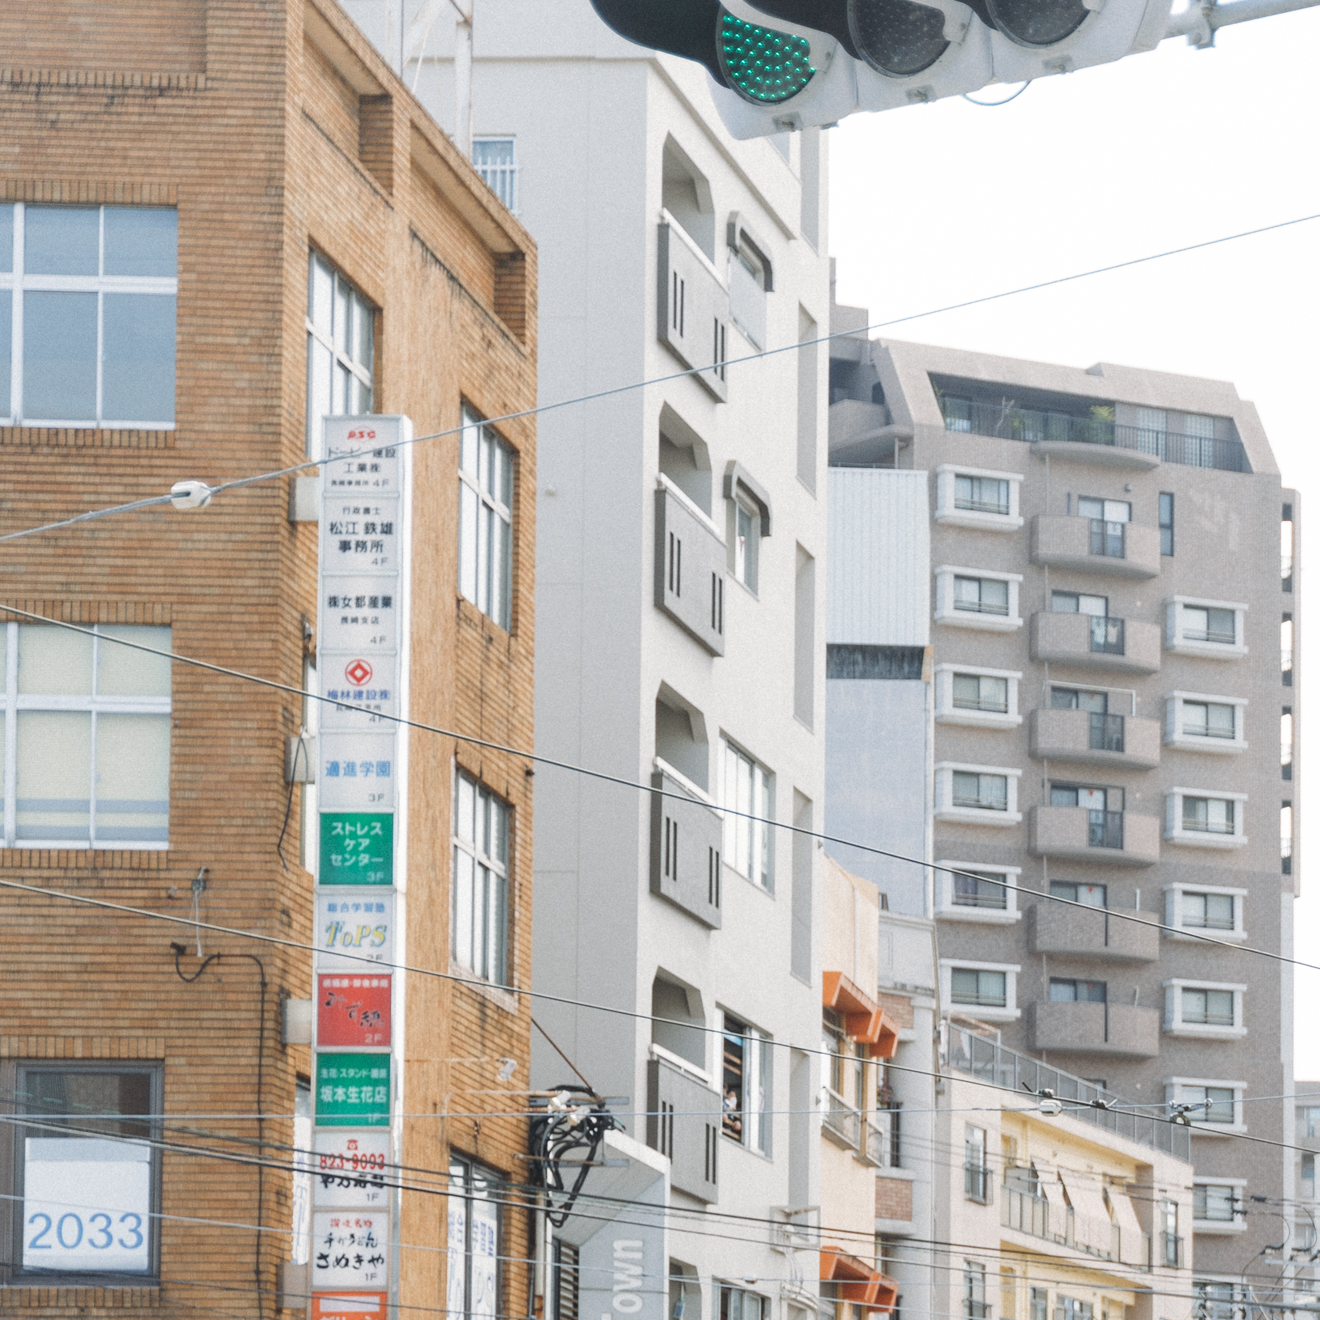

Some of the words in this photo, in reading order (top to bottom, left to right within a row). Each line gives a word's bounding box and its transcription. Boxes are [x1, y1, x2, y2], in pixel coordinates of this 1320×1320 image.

[330, 522, 358, 535] 松江
[339, 540, 383, 553] 事務所
[372, 557, 388, 565] 4F
[370, 636, 386, 644] 4F
[368, 793, 384, 802] 3F
[332, 822, 382, 836] ストレス
[343, 838, 370, 852] ケア
[330, 853, 383, 867] センター
[366, 871, 384, 882] 3F
[365, 1033, 382, 1043] 2F
[320, 1086, 387, 1103] 坂本生花店
[320, 1154, 385, 1170] 823-9093
[367, 1193, 379, 1201] 1F
[28, 1212, 143, 1249] 2033
[317, 1252, 385, 1269] さぬきや
[366, 1273, 377, 1281] 1F
